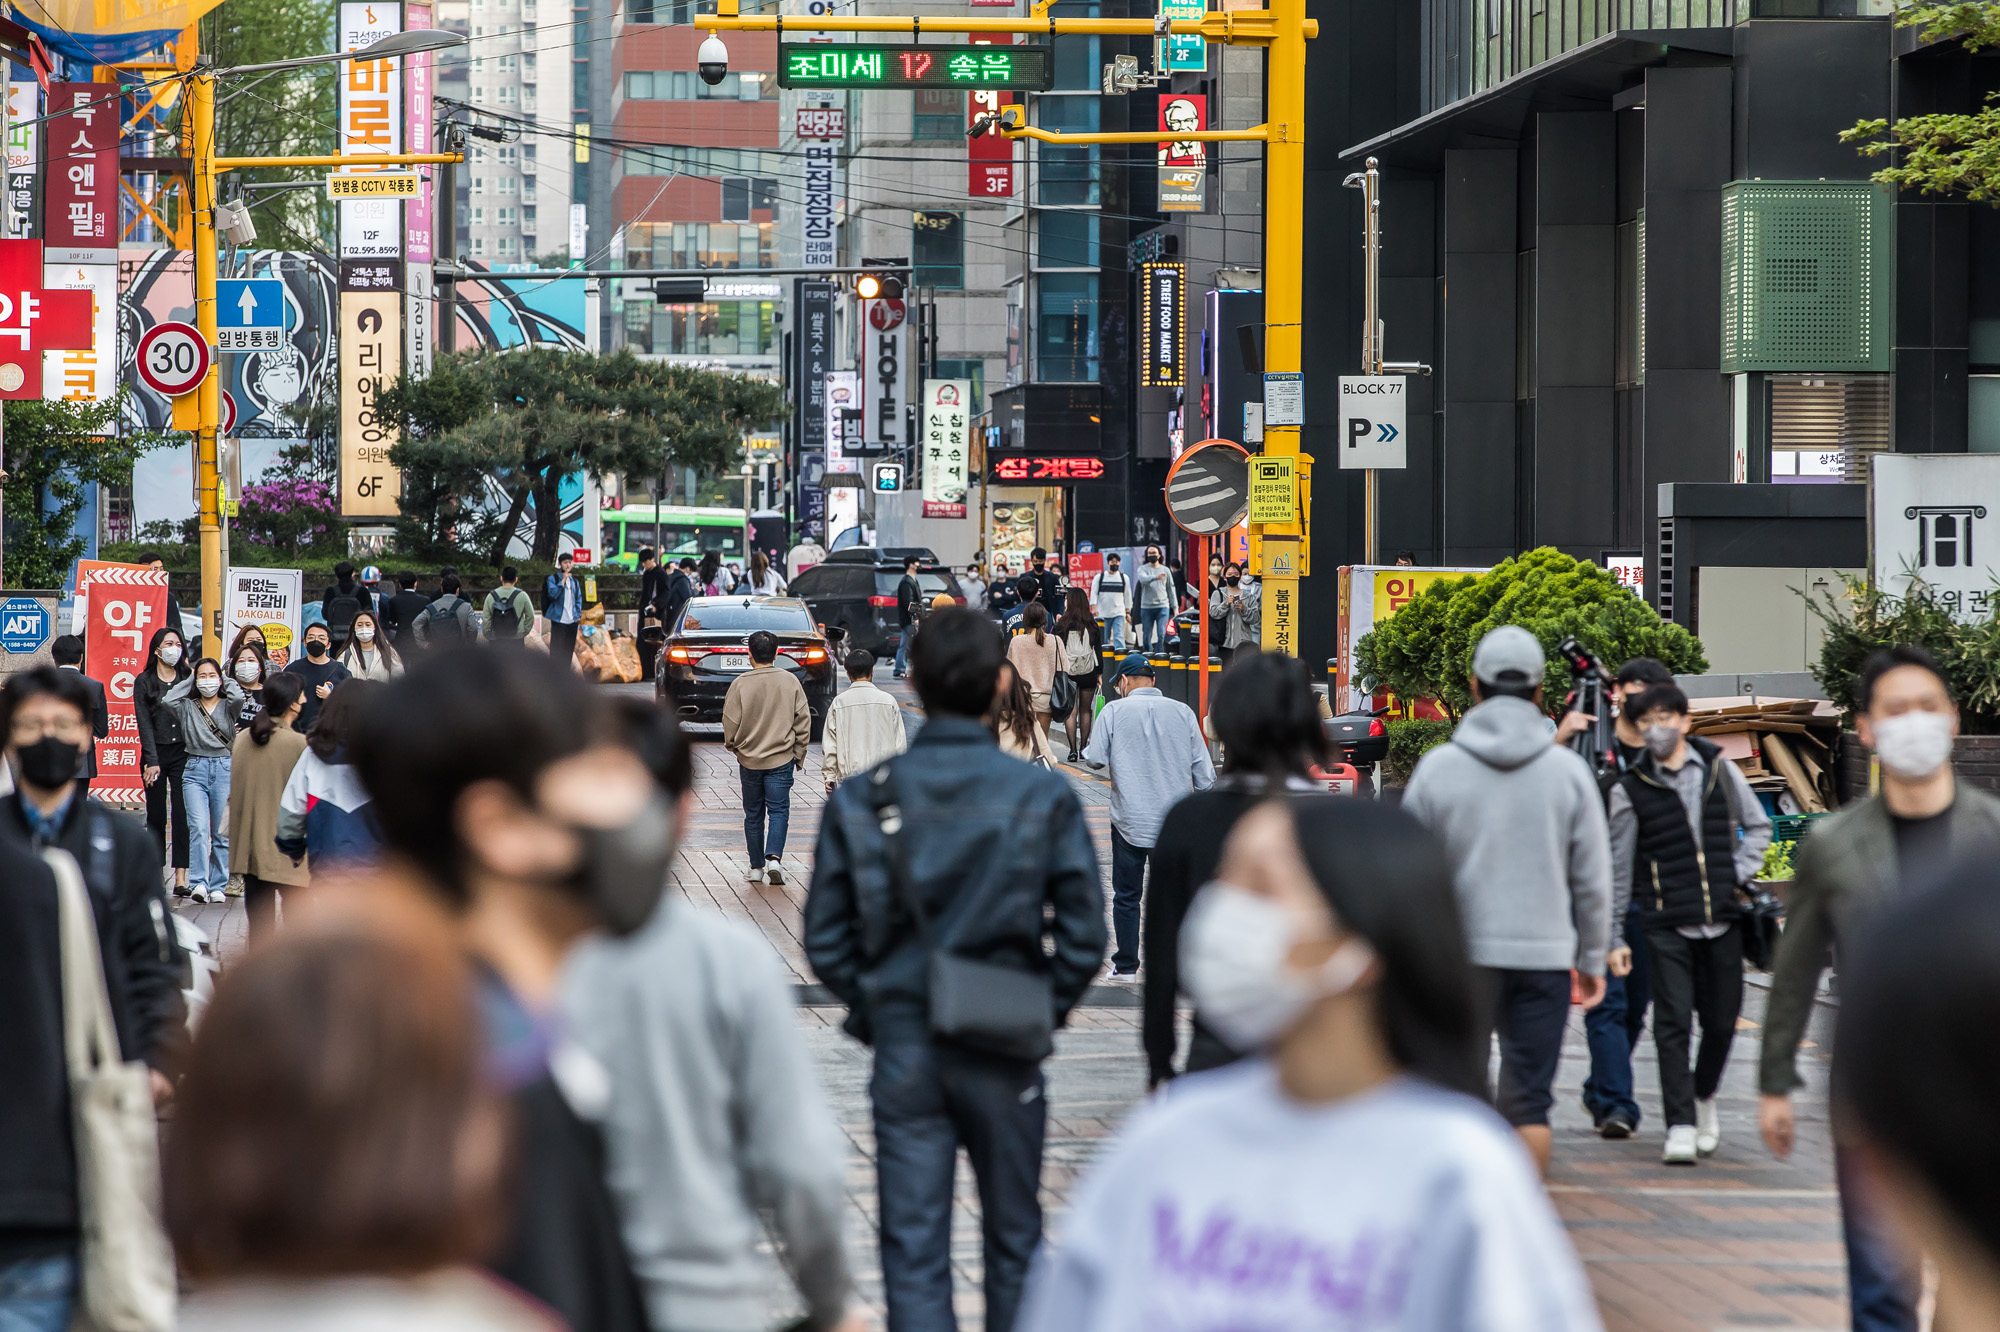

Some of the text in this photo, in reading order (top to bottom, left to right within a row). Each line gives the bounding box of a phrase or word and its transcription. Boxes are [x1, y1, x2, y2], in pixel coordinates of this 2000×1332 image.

[1176, 49, 1190, 61] 2F
[797, 109, 844, 137] 전당포
[985, 167, 1008, 175] WHITE
[1172, 172, 1196, 182] KFC
[12, 175, 32, 189] 4F
[333, 179, 414, 193] 방범용 CCTV 작동중
[986, 178, 1008, 193] 3F
[805, 146, 834, 239] 면접정장
[353, 201, 385, 219] 의원
[94, 212, 105, 237] 의원
[363, 230, 380, 240] 12F
[408, 229, 429, 245] 피부과
[342, 246, 347, 254] T
[349, 246, 399, 255] 02.595.8599
[805, 241, 833, 252] 판매
[805, 253, 833, 265] 대여
[813, 290, 829, 299] SPICE
[1160, 279, 1172, 364] STREET FOOD MARKET
[218, 330, 279, 348] 일방통행
[810, 311, 825, 356] 쌀국수
[152, 342, 195, 374] 30
[812, 361, 823, 374] &
[1160, 367, 1172, 379] 24
[878, 334, 898, 441] HOTEL
[1343, 383, 1403, 394] BLOCK 77
[929, 413, 944, 461] 신의주
[1348, 418, 1372, 448] P
[947, 412, 963, 481] 찹쌀순대
[357, 447, 384, 463] 의원
[879, 468, 897, 479] GS
[996, 457, 1104, 479] 삼계탕
[357, 476, 384, 498] 6F
[880, 478, 896, 489] 25
[247, 593, 287, 609] 닭갈비
[237, 609, 285, 620] DAKGALBI
[3, 615, 40, 635] ADT
[103, 600, 152, 652] 약
[107, 713, 138, 731] 药店
[94, 736, 140, 744] PHARMAC
